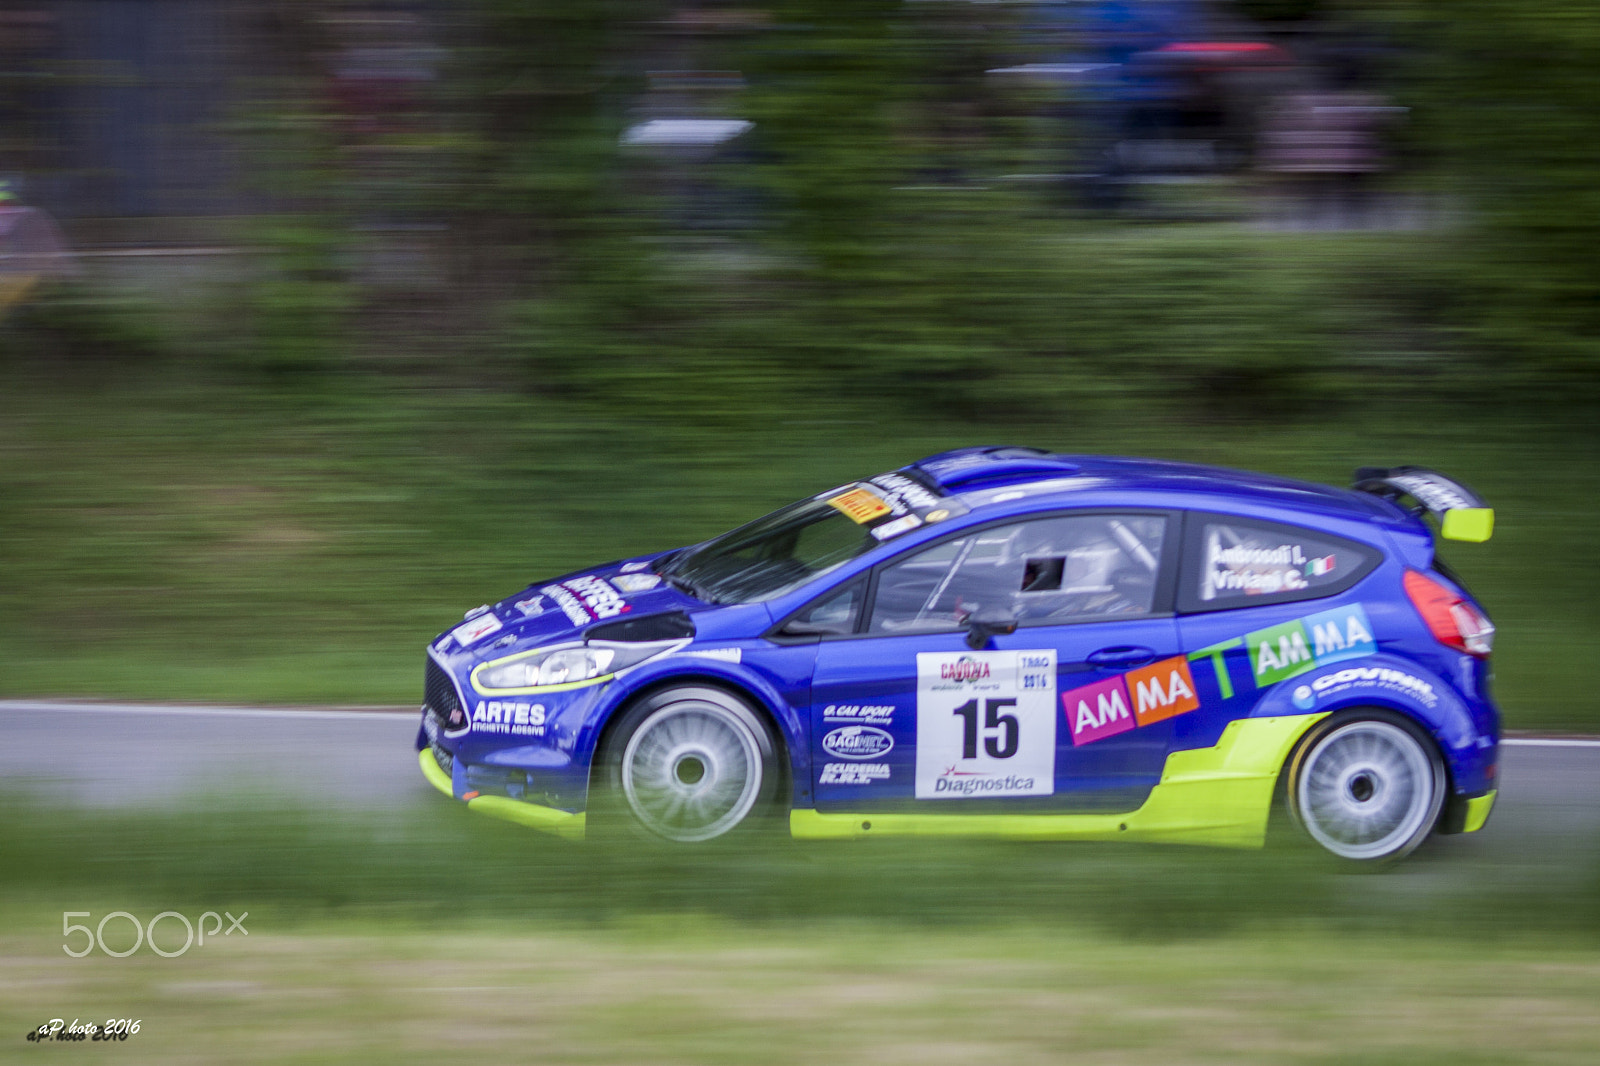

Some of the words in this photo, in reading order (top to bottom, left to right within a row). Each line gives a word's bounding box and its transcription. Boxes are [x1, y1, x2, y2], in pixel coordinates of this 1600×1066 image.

[472, 700, 546, 727] ARTES
[953, 697, 1030, 760] 15
[934, 775, 1035, 795] Diagnostica
